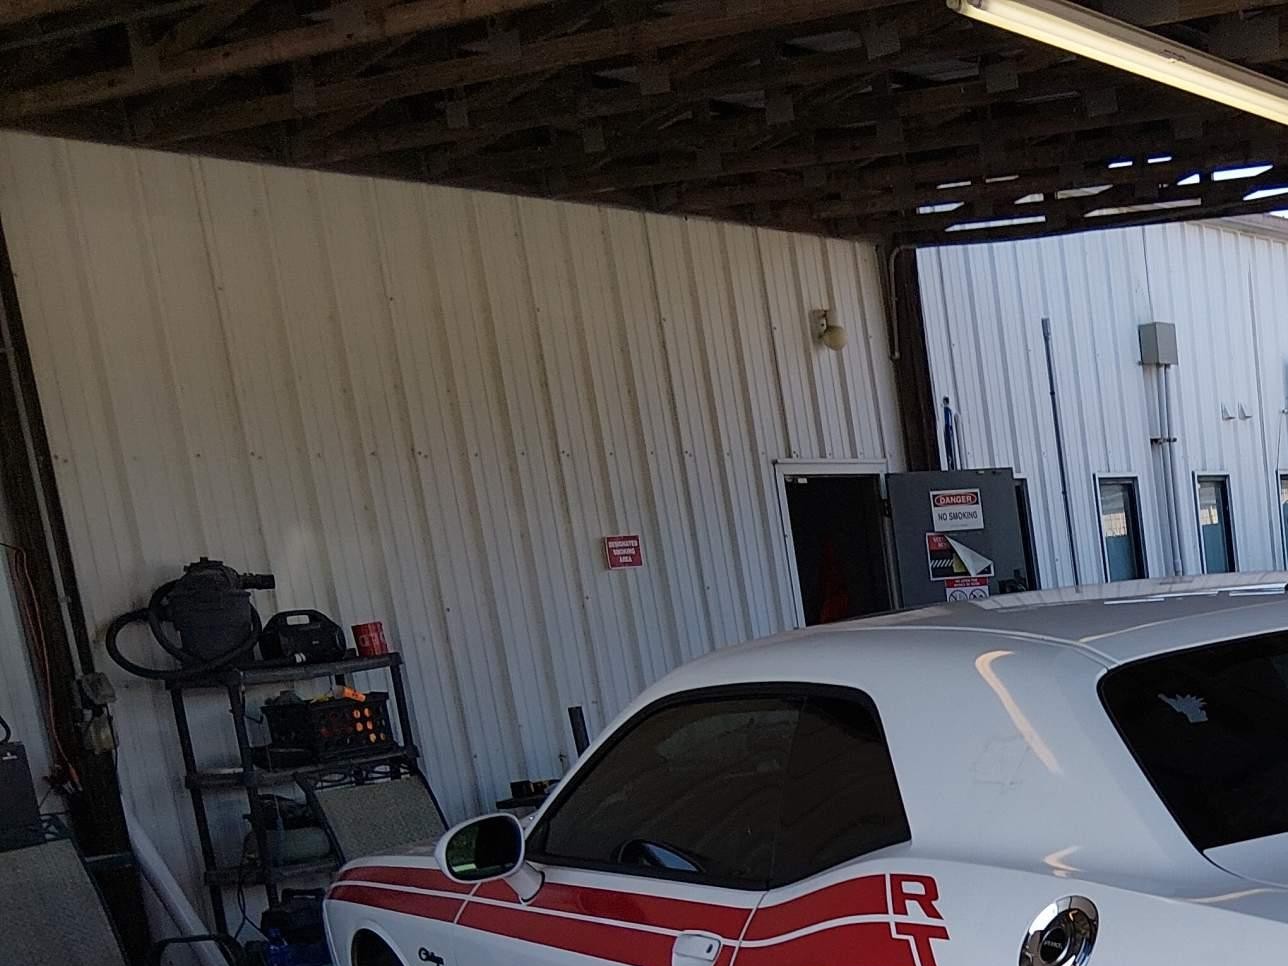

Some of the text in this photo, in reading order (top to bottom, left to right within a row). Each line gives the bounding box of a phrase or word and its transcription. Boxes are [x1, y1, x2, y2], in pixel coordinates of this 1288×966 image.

[939, 495, 973, 504] DANGER
[938, 510, 978, 521] NO SMOKING
